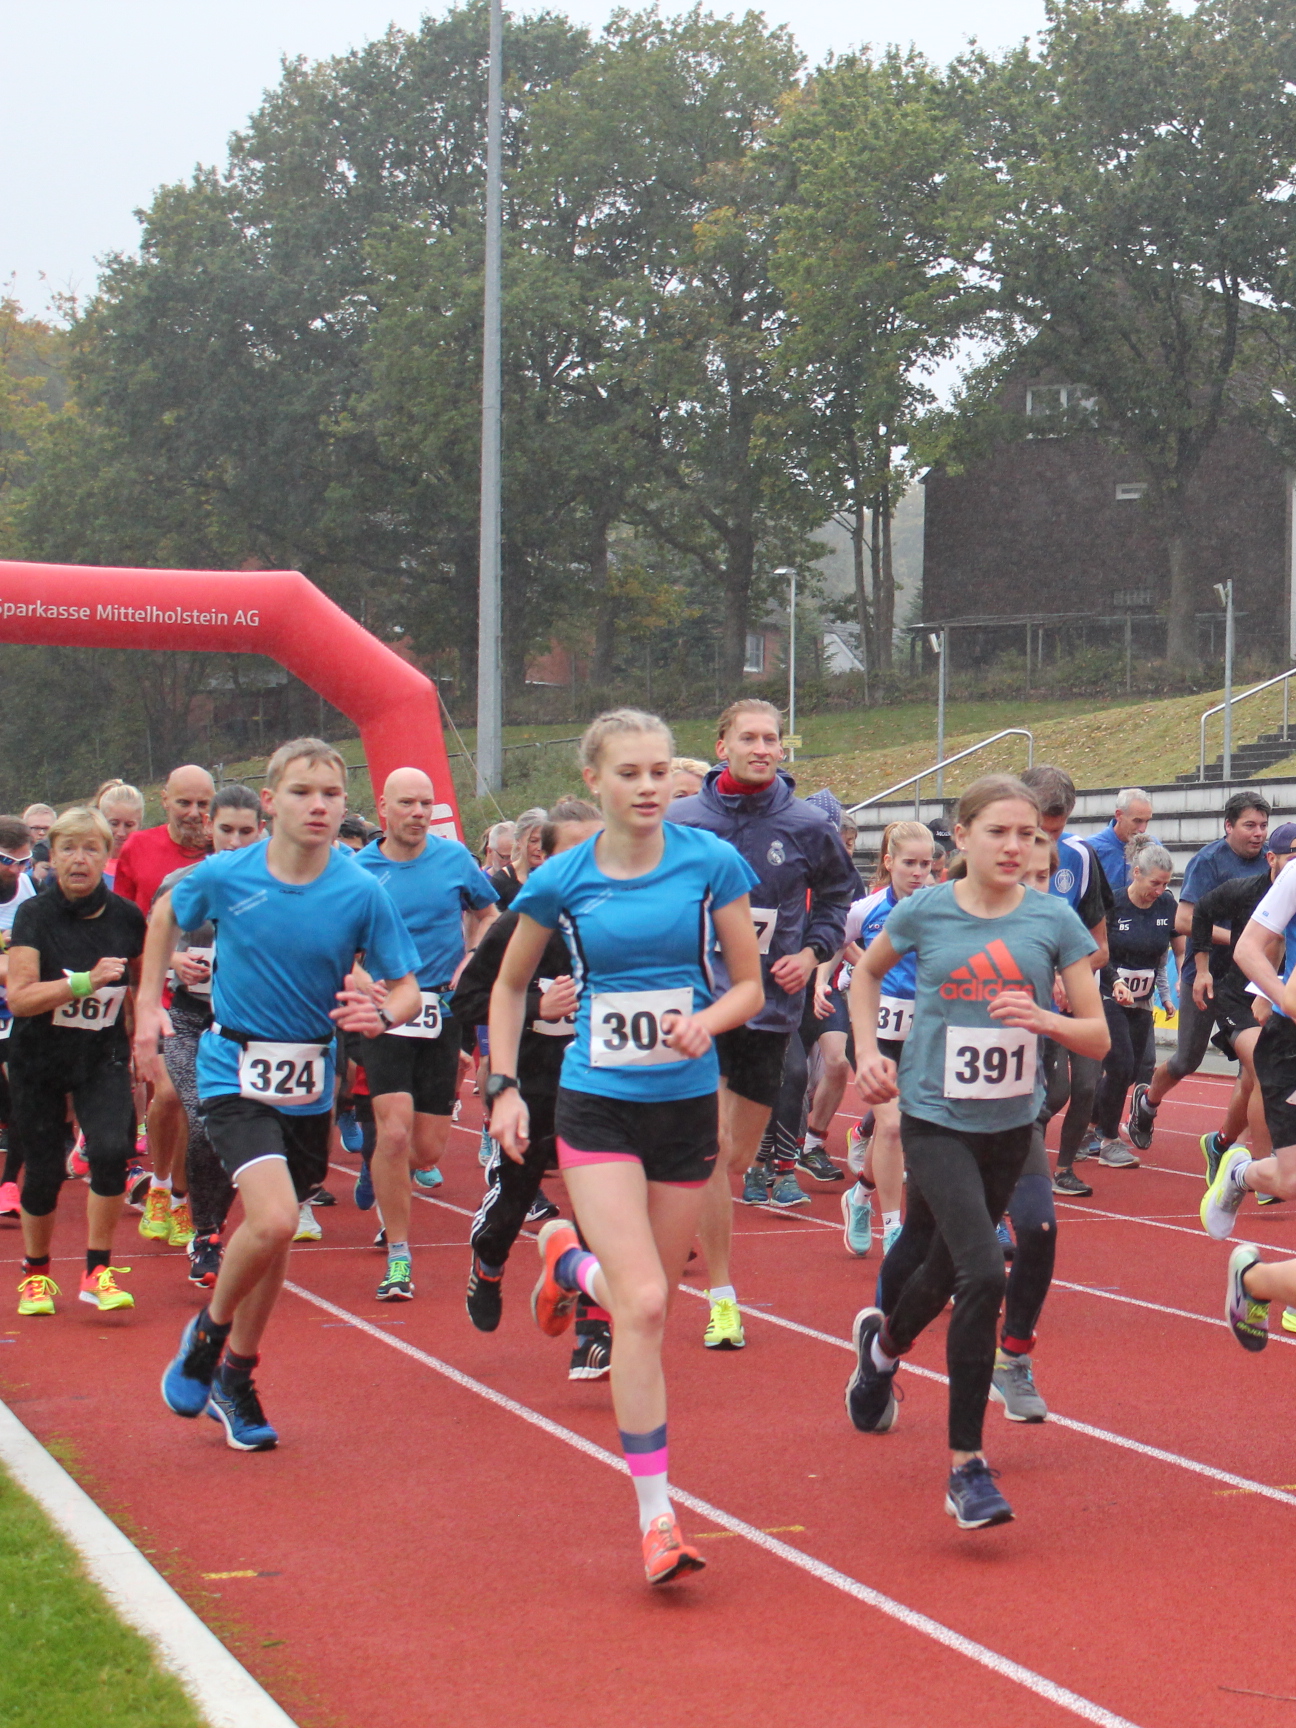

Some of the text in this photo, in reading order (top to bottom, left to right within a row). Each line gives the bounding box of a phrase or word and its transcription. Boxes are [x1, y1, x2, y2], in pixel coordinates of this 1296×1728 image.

[0, 599, 259, 627] parkasse Mittelholstein AG
[1119, 923, 1130, 931] BS
[1156, 918, 1169, 926] BTC
[62, 997, 115, 1020] 361
[249, 1058, 316, 1095] 324
[955, 1044, 1025, 1085] 391
